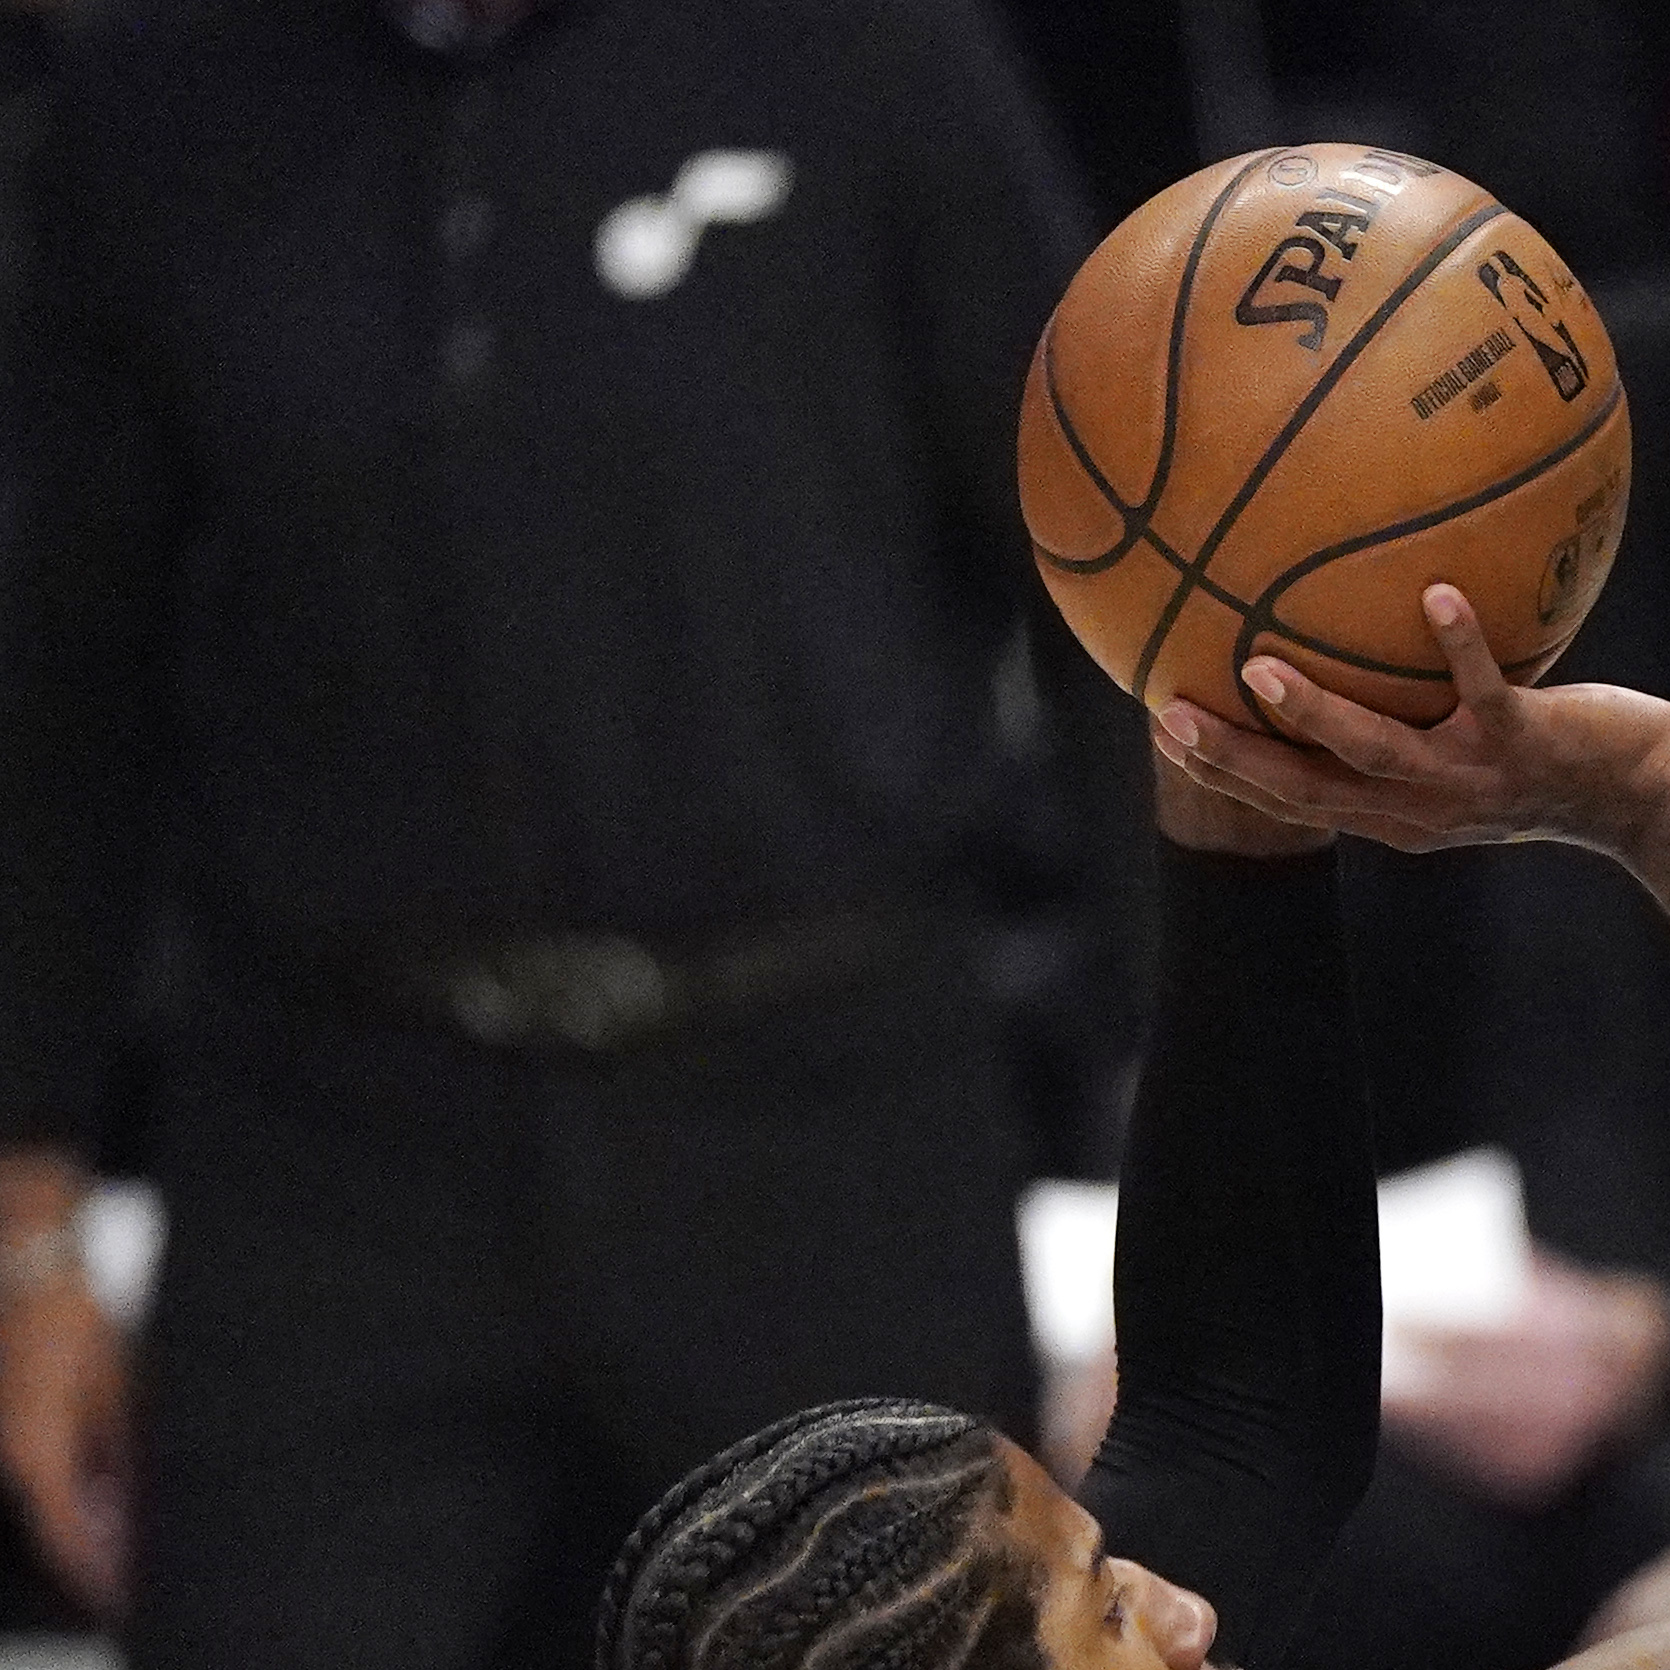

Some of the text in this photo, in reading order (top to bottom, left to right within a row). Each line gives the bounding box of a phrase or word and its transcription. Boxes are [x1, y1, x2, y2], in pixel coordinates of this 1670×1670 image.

[1236, 149, 1443, 351] SPALD
[1410, 367, 1468, 420] OFFICIAL
[1456, 344, 1495, 383] GAME
[1484, 327, 1517, 361] BALL
